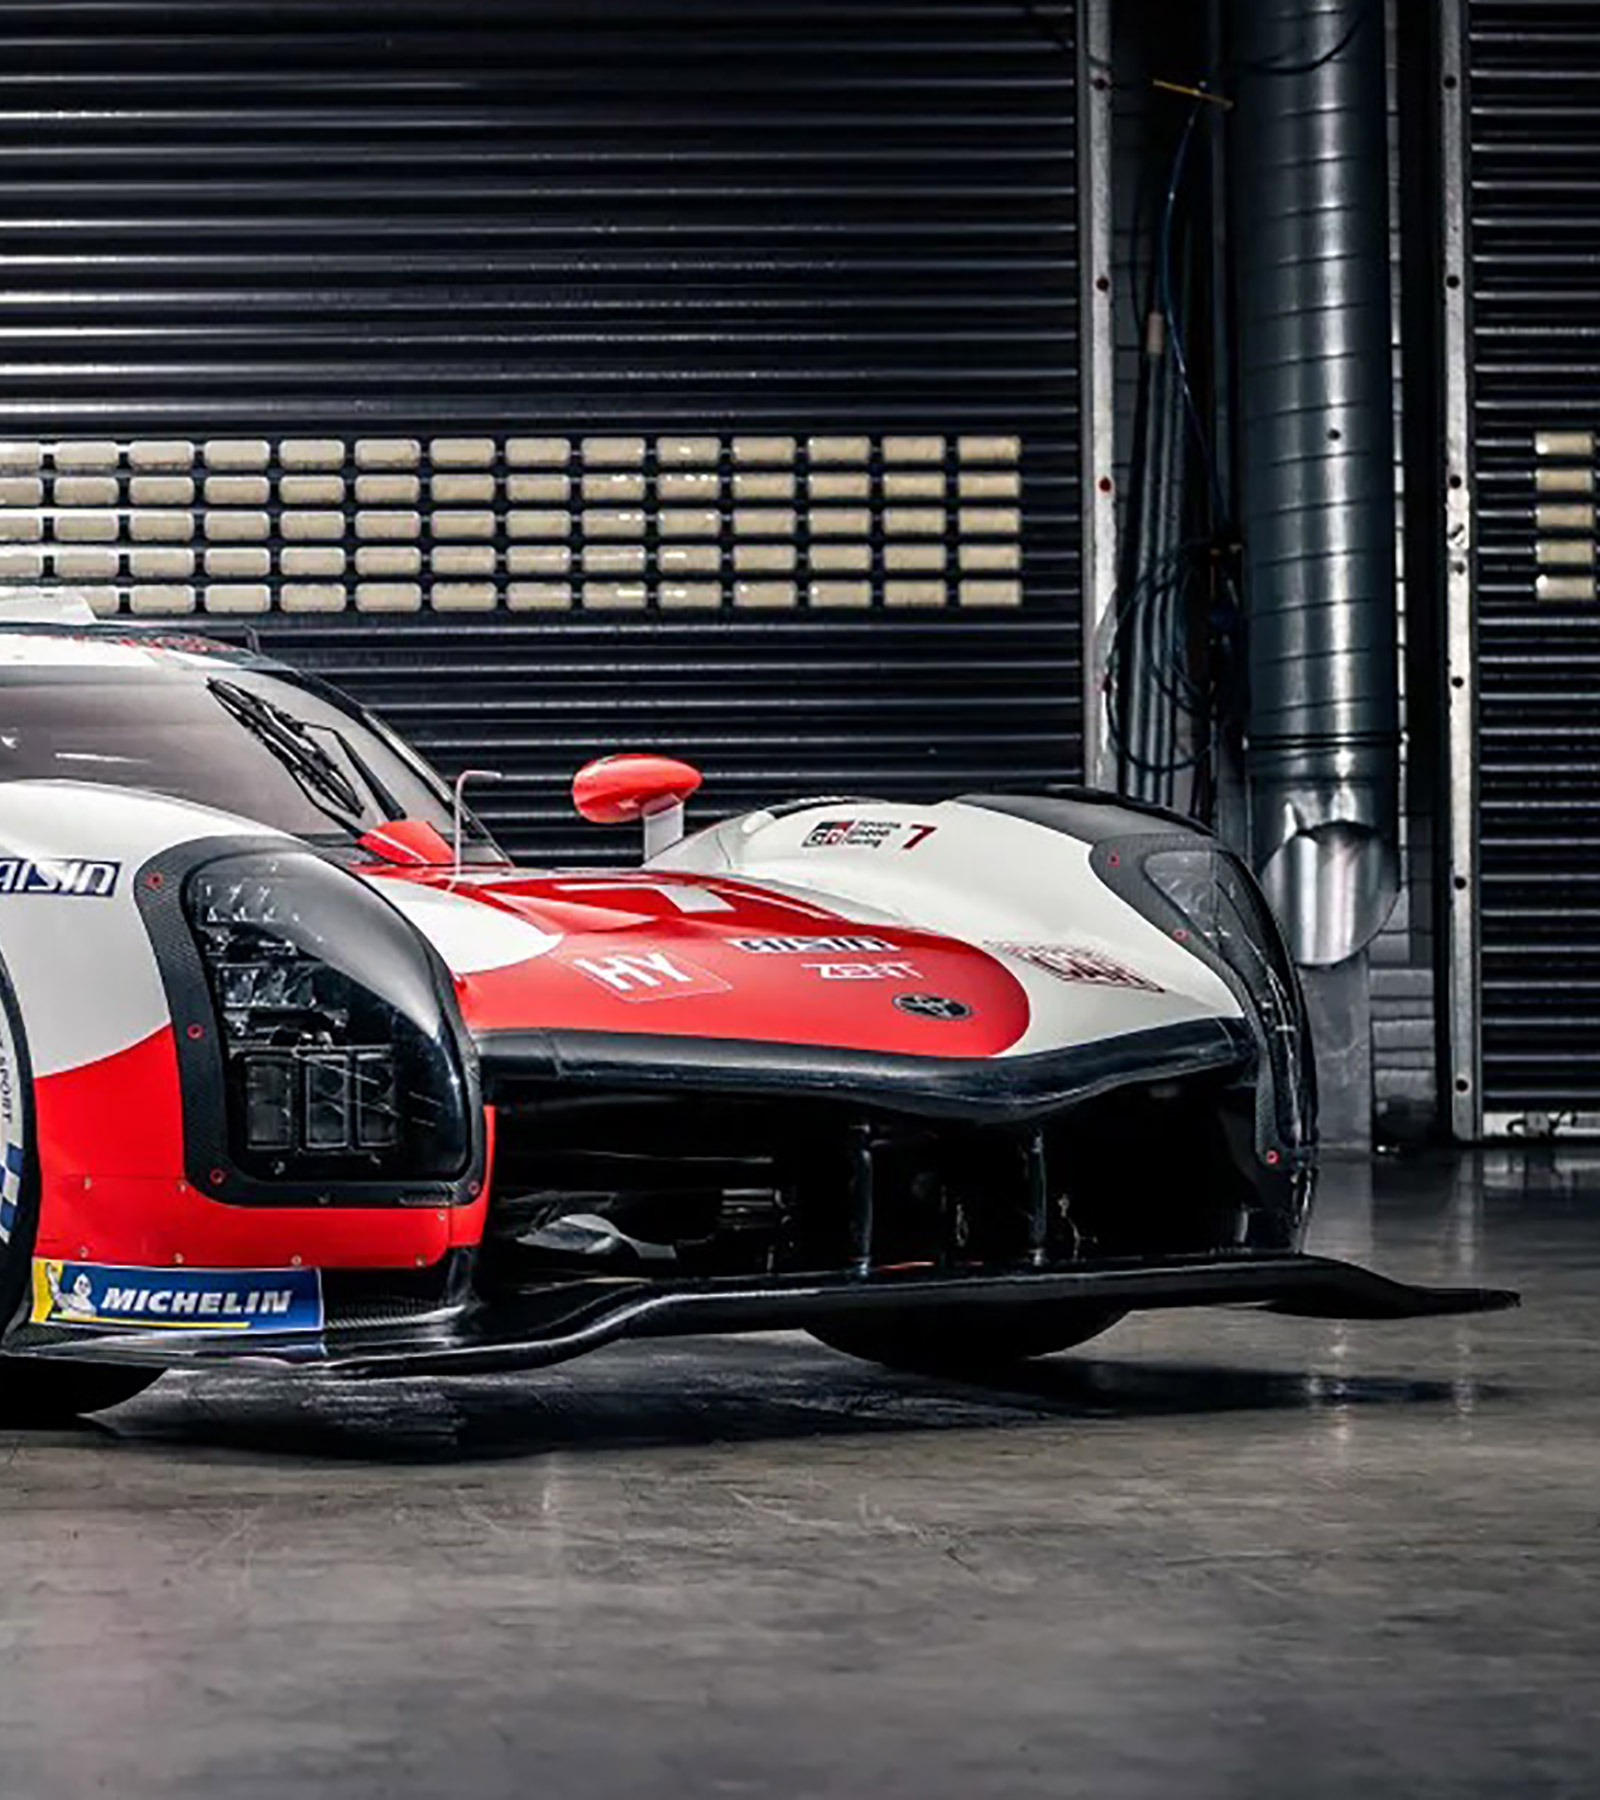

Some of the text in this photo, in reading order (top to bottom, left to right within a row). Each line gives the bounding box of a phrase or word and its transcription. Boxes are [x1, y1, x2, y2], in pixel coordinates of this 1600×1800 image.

[902, 823, 937, 849] 7
[572, 953, 693, 990] HY
[102, 1287, 293, 1314] MICHELIN
